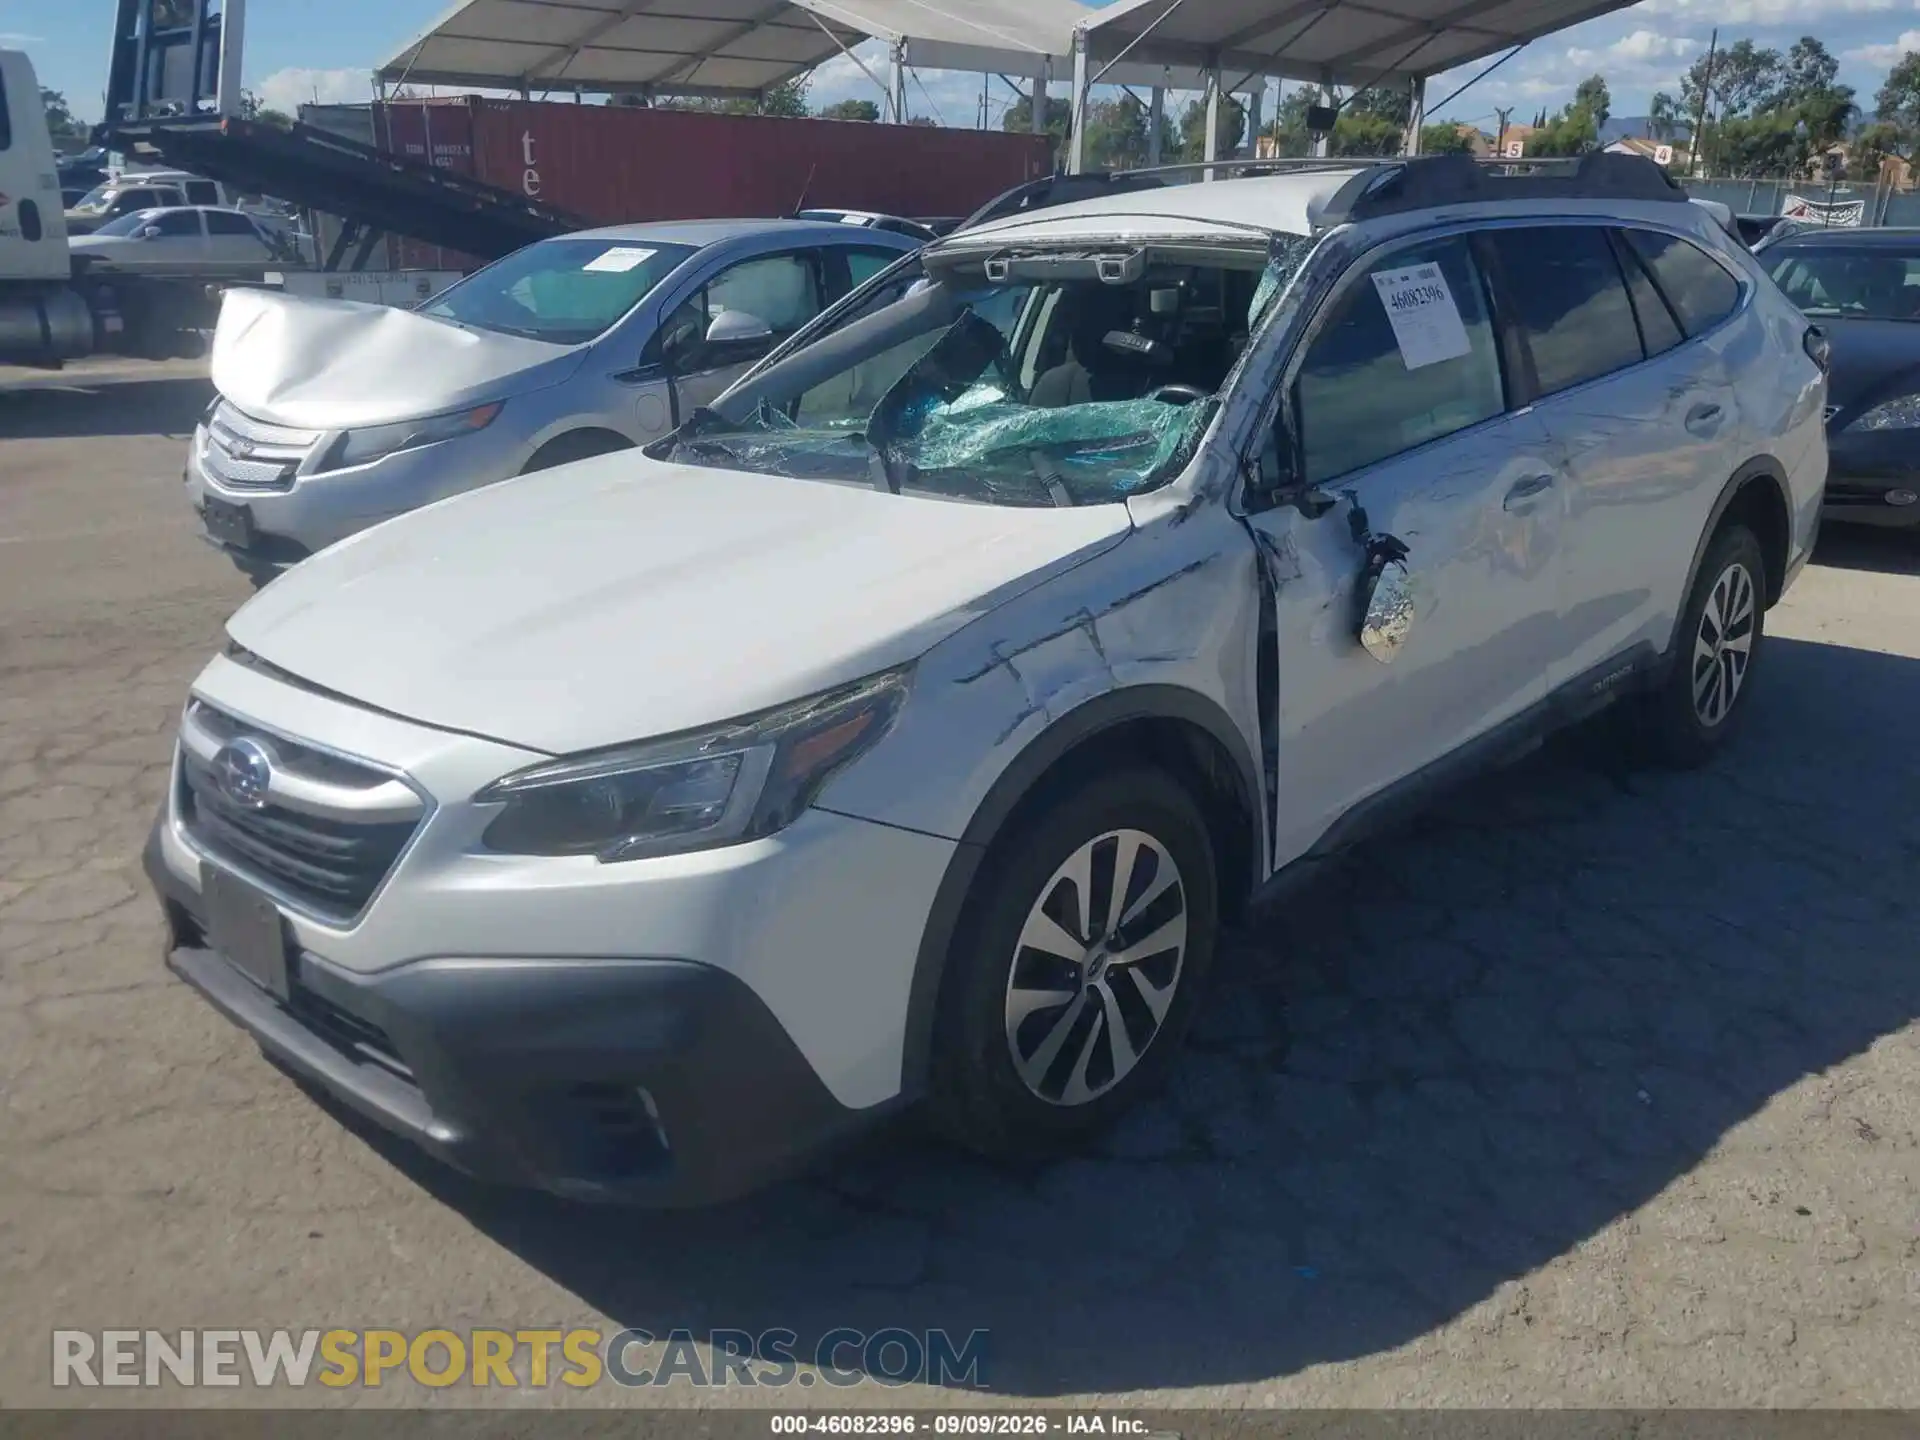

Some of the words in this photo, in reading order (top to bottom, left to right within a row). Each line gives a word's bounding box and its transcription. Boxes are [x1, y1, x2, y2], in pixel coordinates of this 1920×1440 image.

[1510, 143, 1520, 156] 5
[1657, 147, 1668, 162] 4
[1391, 283, 1445, 310] 46082396
